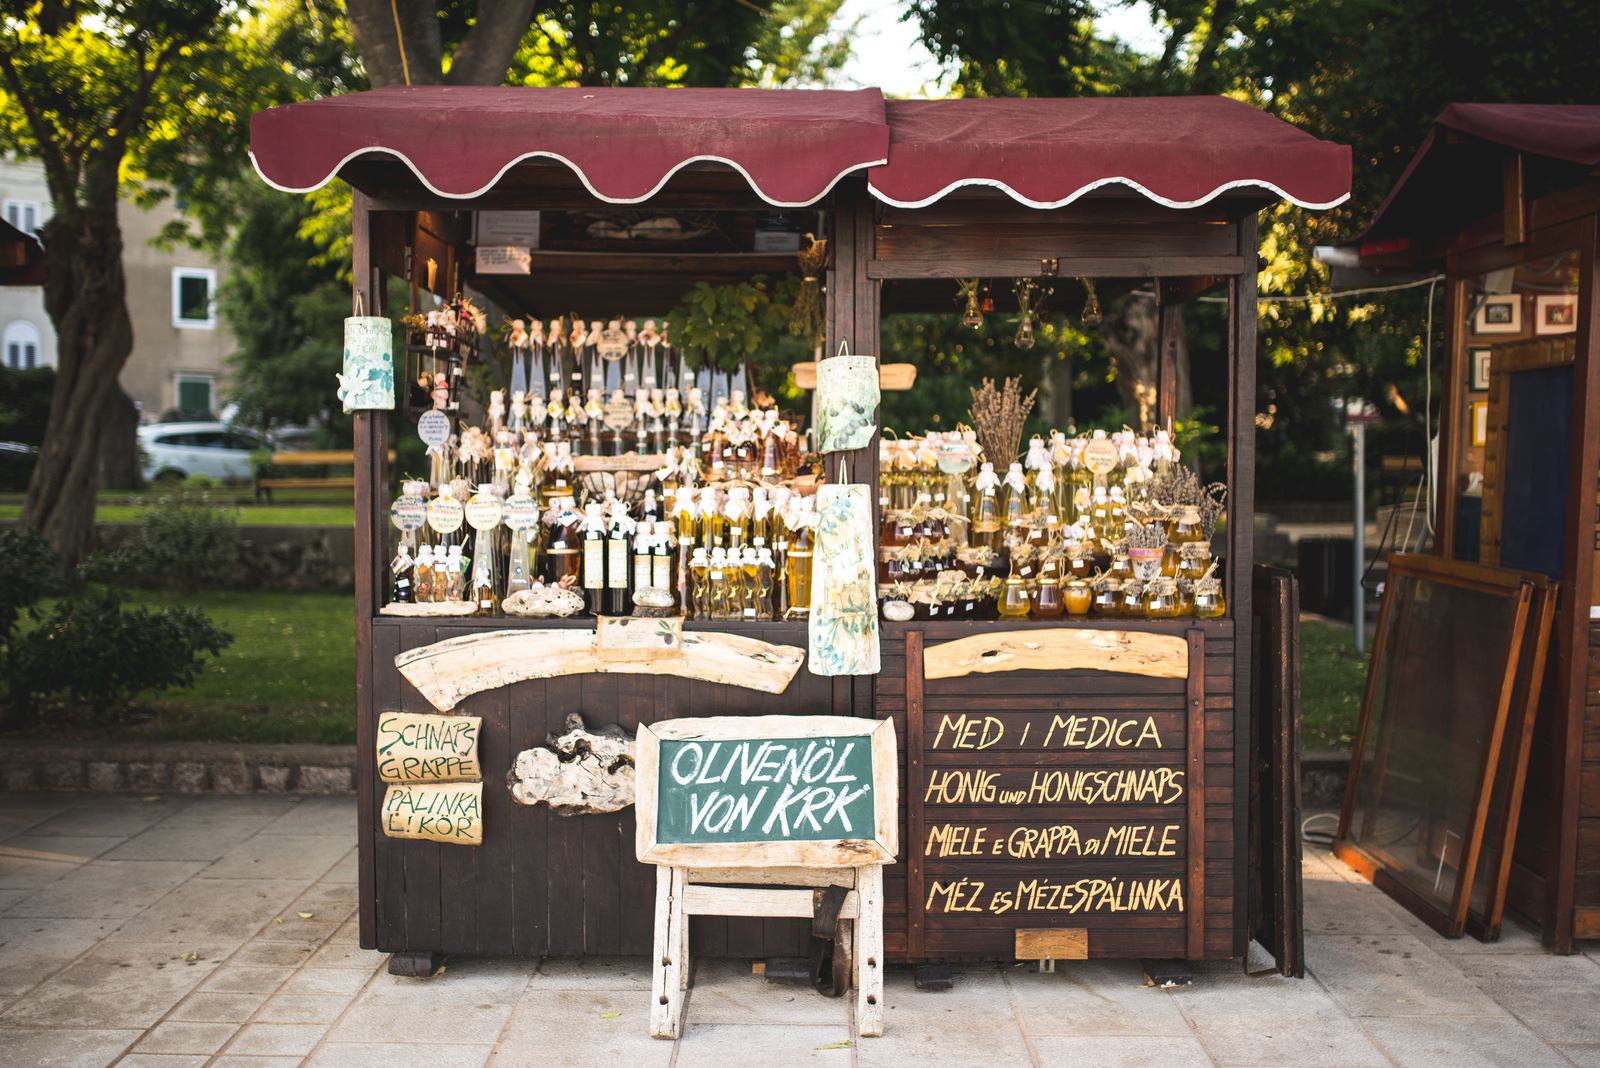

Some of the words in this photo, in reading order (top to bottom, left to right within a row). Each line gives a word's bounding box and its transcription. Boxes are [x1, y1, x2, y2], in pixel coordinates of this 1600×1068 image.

[379, 717, 476, 757] SCHNAPS
[933, 714, 1004, 750] MED
[1044, 714, 1162, 750] MEDICA
[379, 757, 478, 780] GRAPPE
[671, 739, 857, 785] OLIVENÖL
[925, 769, 1001, 803] HONIG
[1027, 767, 1185, 804] HONIGSCHNAPS
[690, 786, 769, 835] VON
[761, 783, 872, 837] KRK
[925, 823, 987, 857] MIELE
[992, 839, 1005, 855] E
[1008, 825, 1082, 859] GRAPPA
[1083, 839, 1101, 856] DI
[1101, 825, 1180, 856] MIELE
[926, 877, 984, 912] MÉZ
[1014, 877, 1184, 914] MÉZESPÁLINKA
